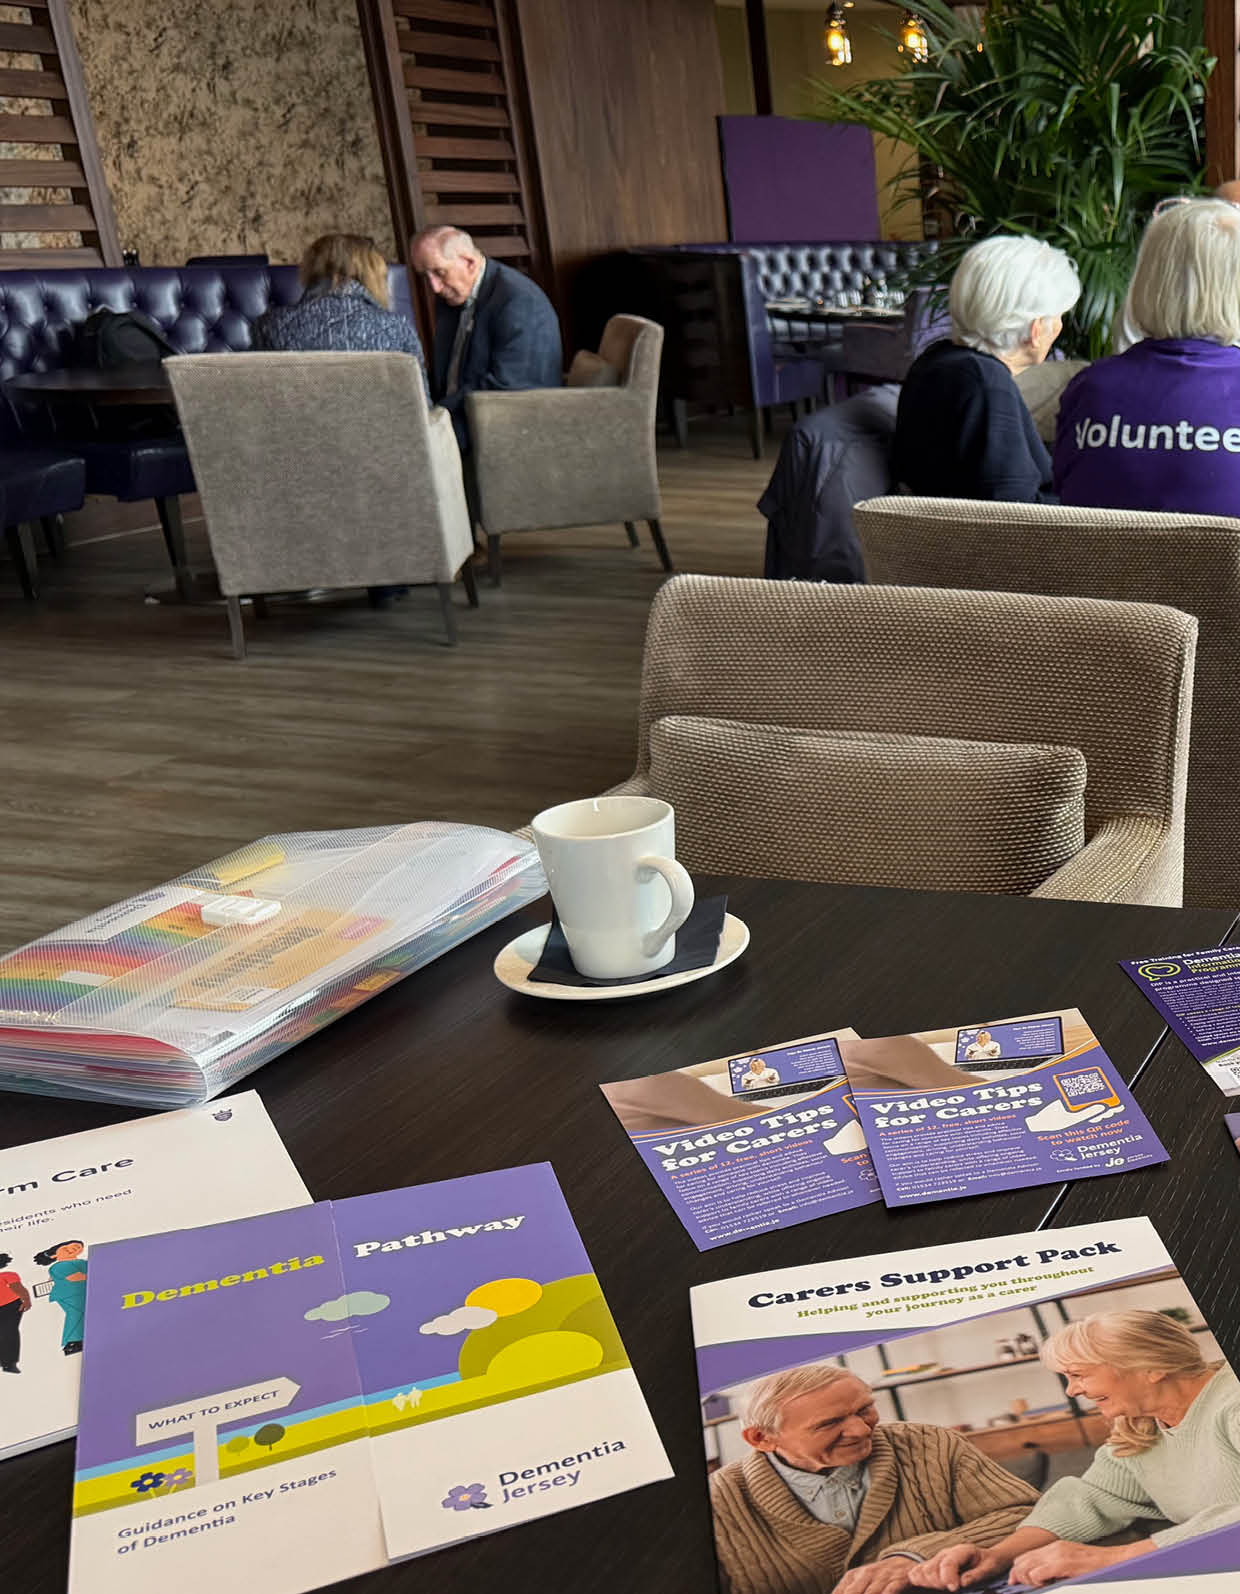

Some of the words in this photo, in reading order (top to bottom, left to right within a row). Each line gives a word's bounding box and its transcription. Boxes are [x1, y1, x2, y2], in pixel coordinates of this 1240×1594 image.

[870, 1095, 966, 1115] Video
[972, 1082, 1044, 1101] Tips
[874, 1113, 927, 1129] for
[936, 1096, 1044, 1120] Carers
[652, 1126, 755, 1157] Video
[760, 1104, 835, 1131] Tips
[661, 1150, 717, 1172] for
[726, 1118, 838, 1154] Carers
[1036, 1133, 1063, 1142] Scan
[1064, 1128, 1085, 1137] this
[1086, 1125, 1103, 1134] QR
[1105, 1119, 1130, 1129] code
[1065, 1133, 1099, 1144] watch
[1100, 1128, 1124, 1138] now
[1077, 1133, 1144, 1153] Dementia
[709, 1164, 719, 1172] of
[759, 1146, 784, 1158] short
[1080, 1147, 1122, 1161] Jersey
[0, 1181, 39, 1195] m
[52, 1158, 134, 1183] Care
[0, 1208, 57, 1227] sidents
[61, 1199, 92, 1212] who
[95, 1188, 133, 1203] need
[353, 1215, 526, 1258] Pathway
[121, 1254, 325, 1310] Dementia
[749, 1279, 873, 1309] Carers
[879, 1253, 1031, 1289] Support
[1036, 1241, 1123, 1265] Pack
[796, 1301, 859, 1319] Helping
[861, 1296, 891, 1309] and
[893, 1284, 978, 1305] supporting
[980, 1279, 1009, 1293] you
[1010, 1265, 1095, 1288] throughout
[865, 1304, 902, 1319] your
[905, 1294, 965, 1313] journey
[967, 1292, 986, 1302] as
[998, 1283, 1038, 1298] carer
[148, 1412, 195, 1430] WHAT
[199, 1406, 220, 1417] TO
[224, 1389, 281, 1411] EXPECT
[499, 1439, 627, 1487] Dementia
[118, 1506, 208, 1540] Guidance
[212, 1499, 237, 1514] on
[242, 1488, 275, 1505] Key
[279, 1469, 338, 1493] Stages
[502, 1469, 582, 1504] Jersey
[117, 1540, 139, 1555] of
[143, 1514, 237, 1549] Dementia
